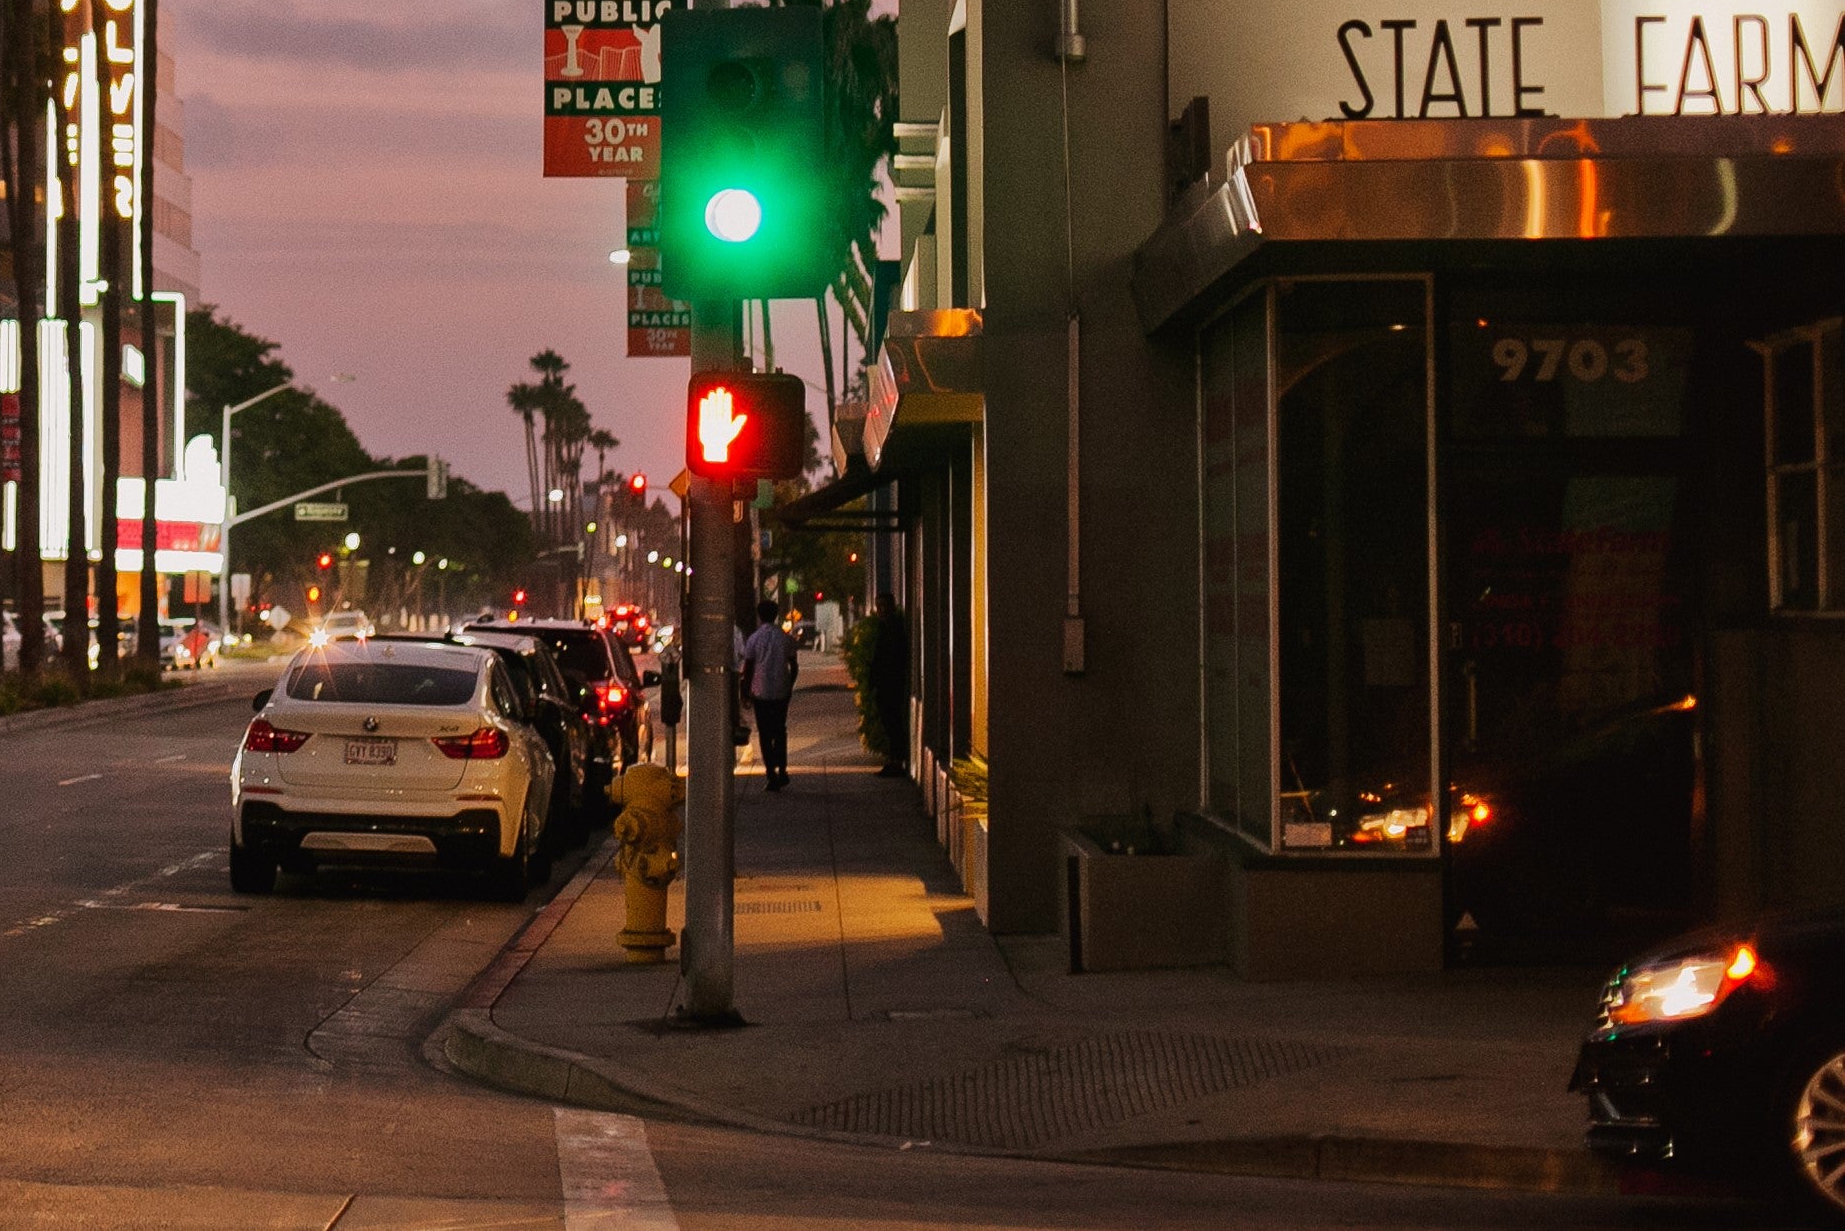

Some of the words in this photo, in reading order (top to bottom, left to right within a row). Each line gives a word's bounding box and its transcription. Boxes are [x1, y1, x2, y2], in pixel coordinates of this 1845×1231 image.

[1337, 17, 1546, 118] STATE
[1635, 12, 1845, 115] FARM
[554, 87, 662, 110] PLACE
[584, 118, 648, 145] 30TH
[588, 146, 643, 162] YEAR
[631, 273, 662, 284] PUB
[631, 314, 690, 325] PLACES
[1491, 339, 1649, 383] 9703
